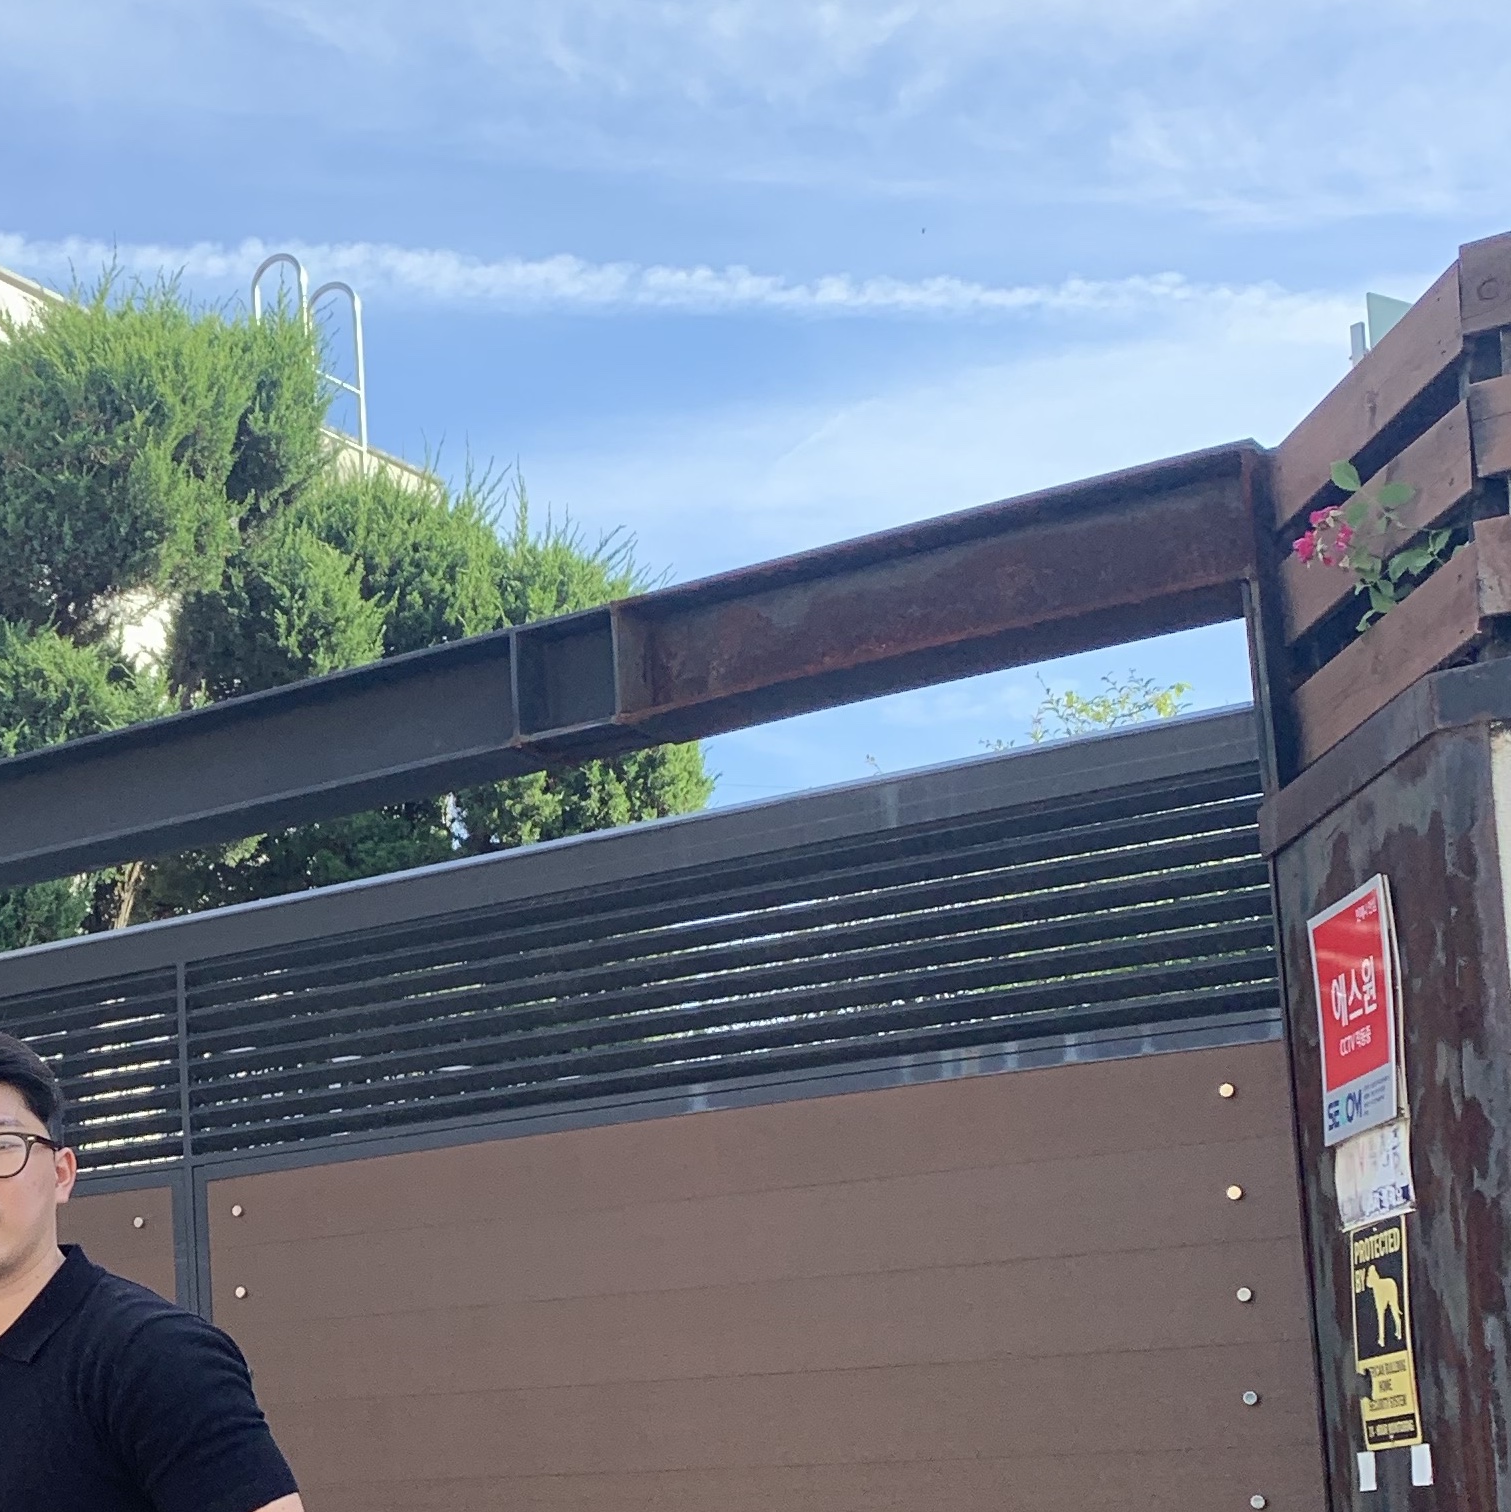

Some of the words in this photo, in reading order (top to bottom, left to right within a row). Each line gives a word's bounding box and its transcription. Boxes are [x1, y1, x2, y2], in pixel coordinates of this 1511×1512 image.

[1331, 955, 1377, 1027] 에스원
[1339, 1034, 1356, 1056] CCTV
[1328, 1089, 1362, 1131] SECOM
[1354, 1227, 1400, 1265] PROTECTED
[1355, 1268, 1366, 1293] BY
[1369, 1397, 1389, 1412] SECURITY
[1390, 1394, 1407, 1409] SYSTEM
